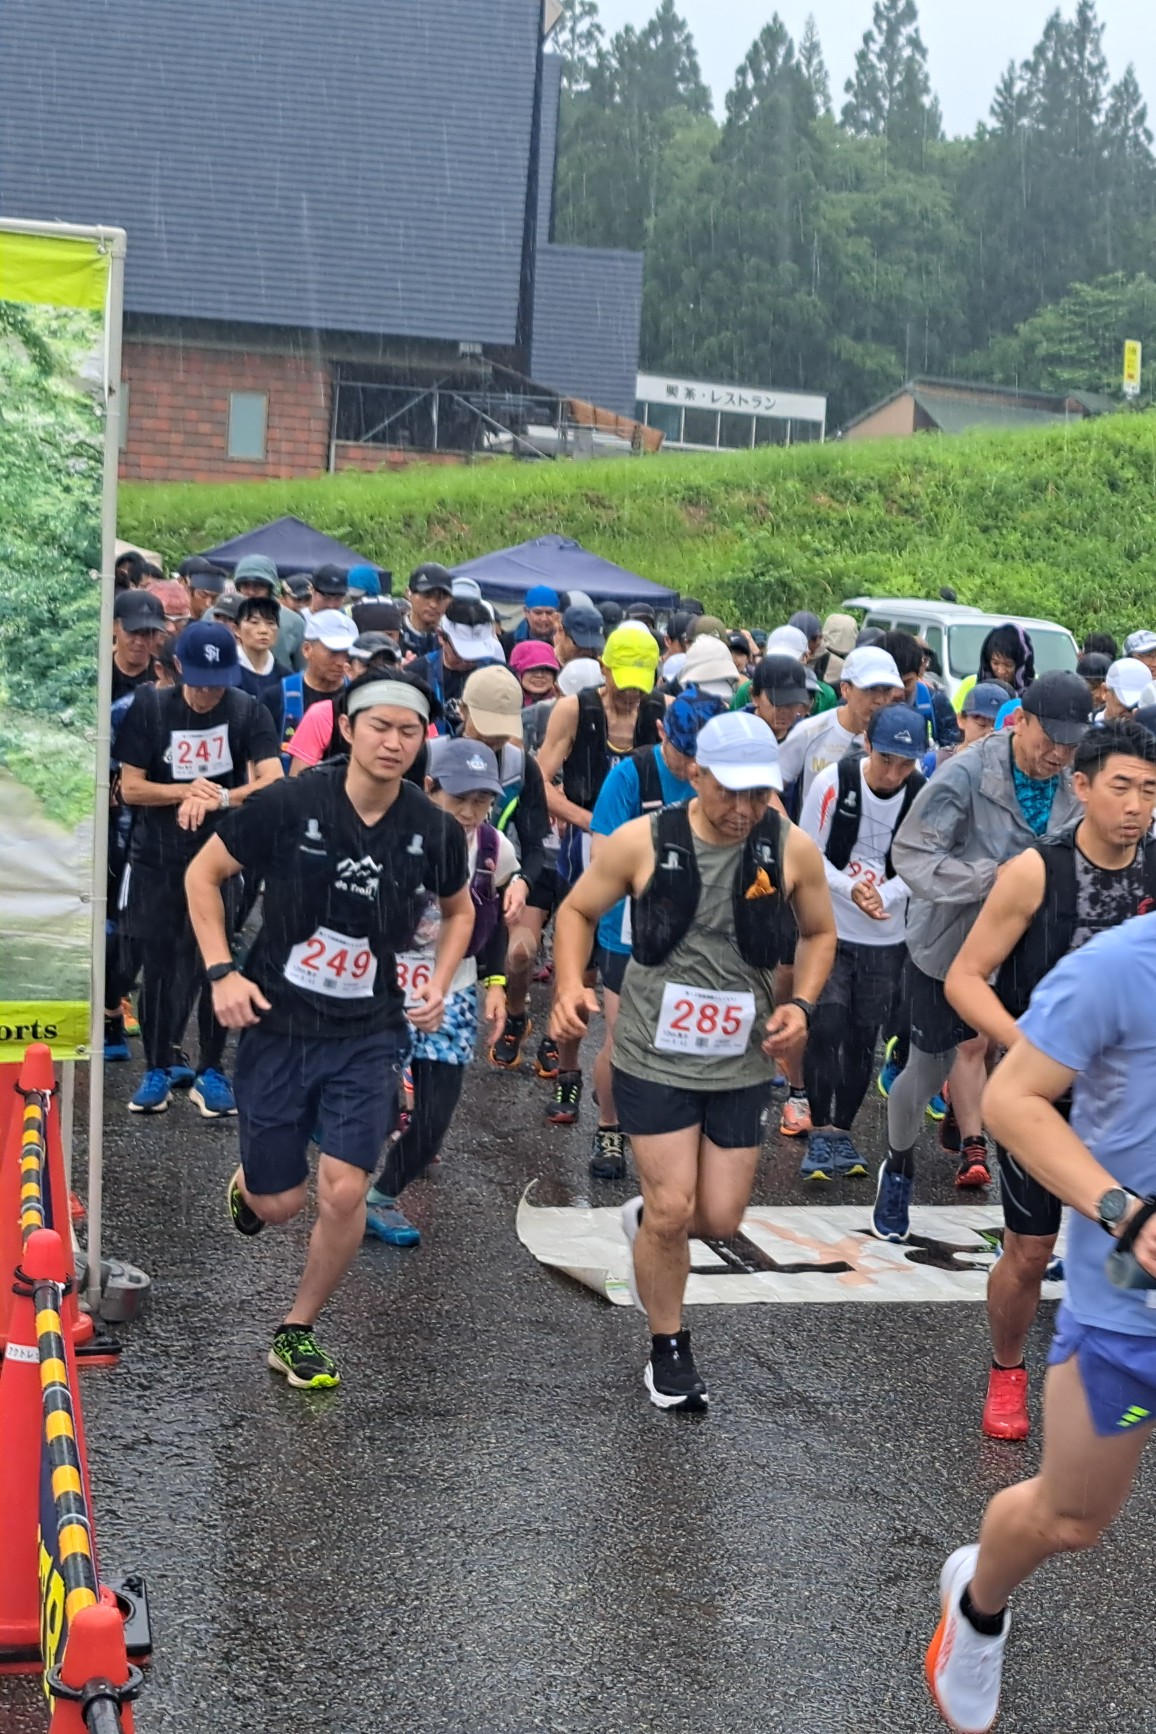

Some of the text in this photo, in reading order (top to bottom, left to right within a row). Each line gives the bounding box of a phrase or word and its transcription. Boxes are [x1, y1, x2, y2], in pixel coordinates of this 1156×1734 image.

[665, 383, 777, 411] 喫茶・レストラン
[177, 736, 224, 764] 247
[300, 937, 371, 980] 249
[670, 998, 742, 1035] 285
